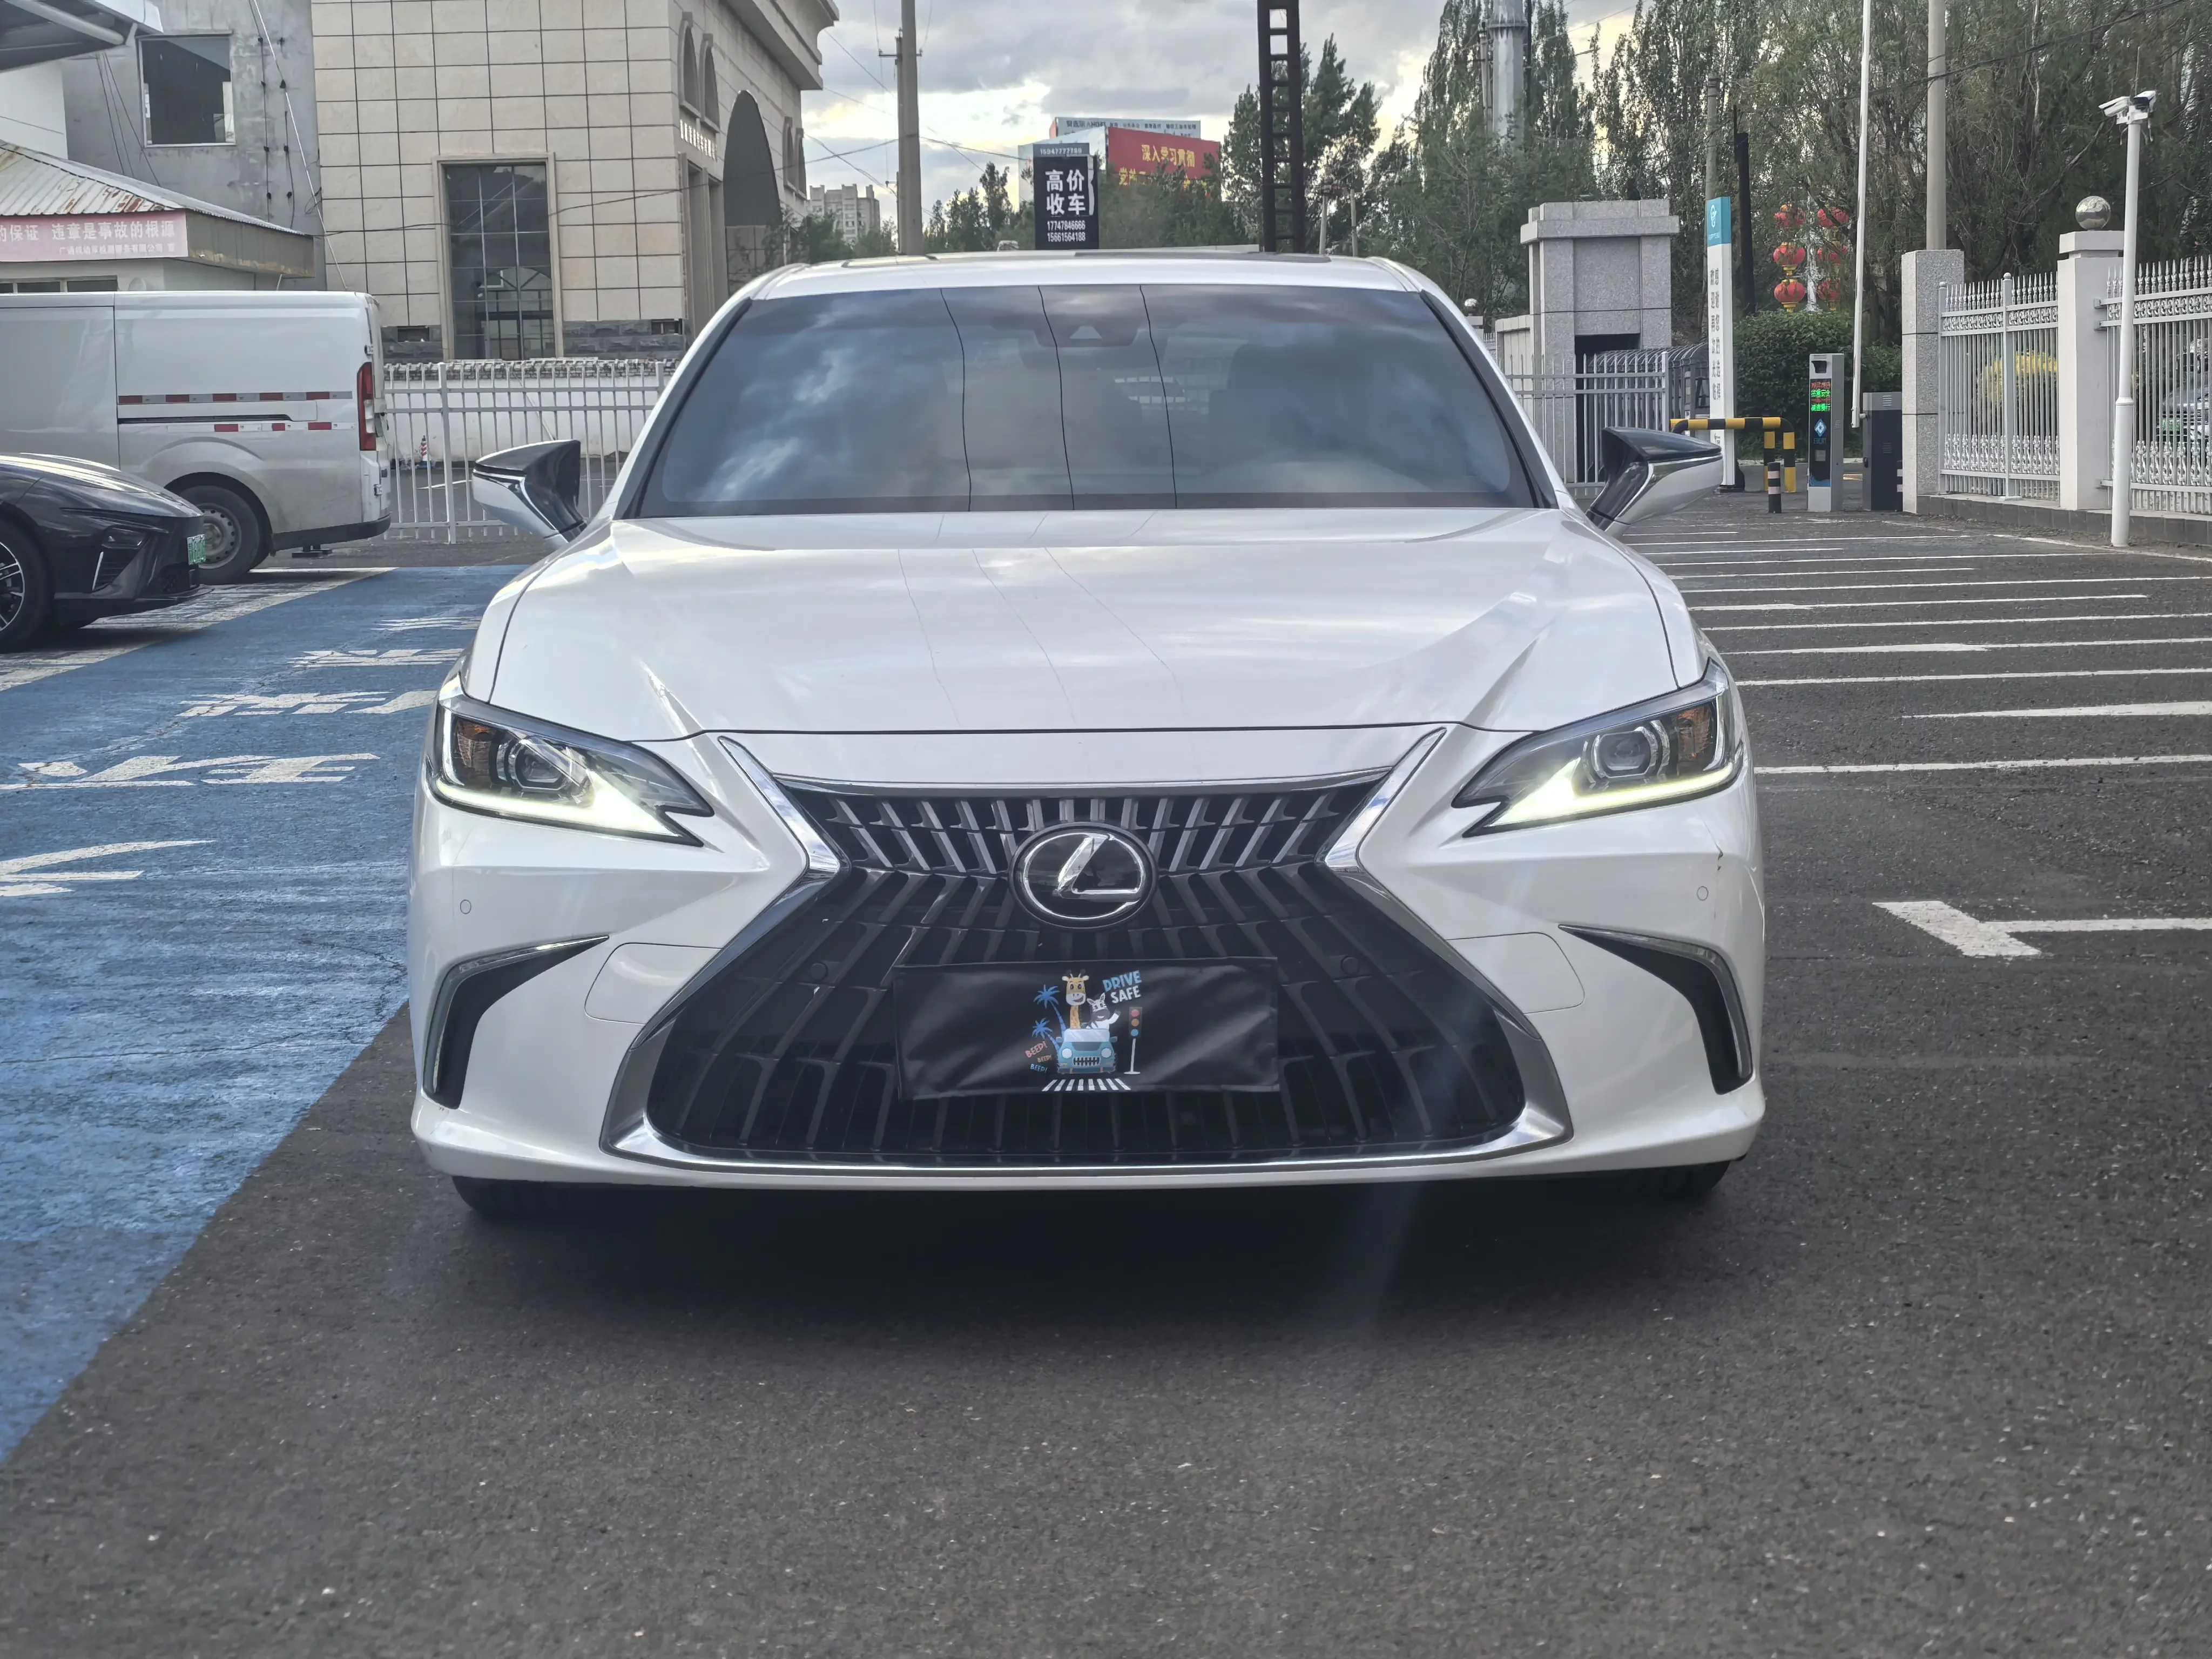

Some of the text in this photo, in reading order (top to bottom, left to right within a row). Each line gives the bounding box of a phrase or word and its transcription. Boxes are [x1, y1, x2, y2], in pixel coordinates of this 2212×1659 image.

[1045, 169, 1085, 192] 高价
[1046, 193, 1085, 215] 收车
[52, 220, 175, 241] 违章是事故的根源
[1047, 220, 1085, 231] 17747846666
[1047, 232, 1085, 242] 15661564188
[1103, 970, 1142, 992] DRIVE
[1111, 986, 1141, 1003] SAFE
